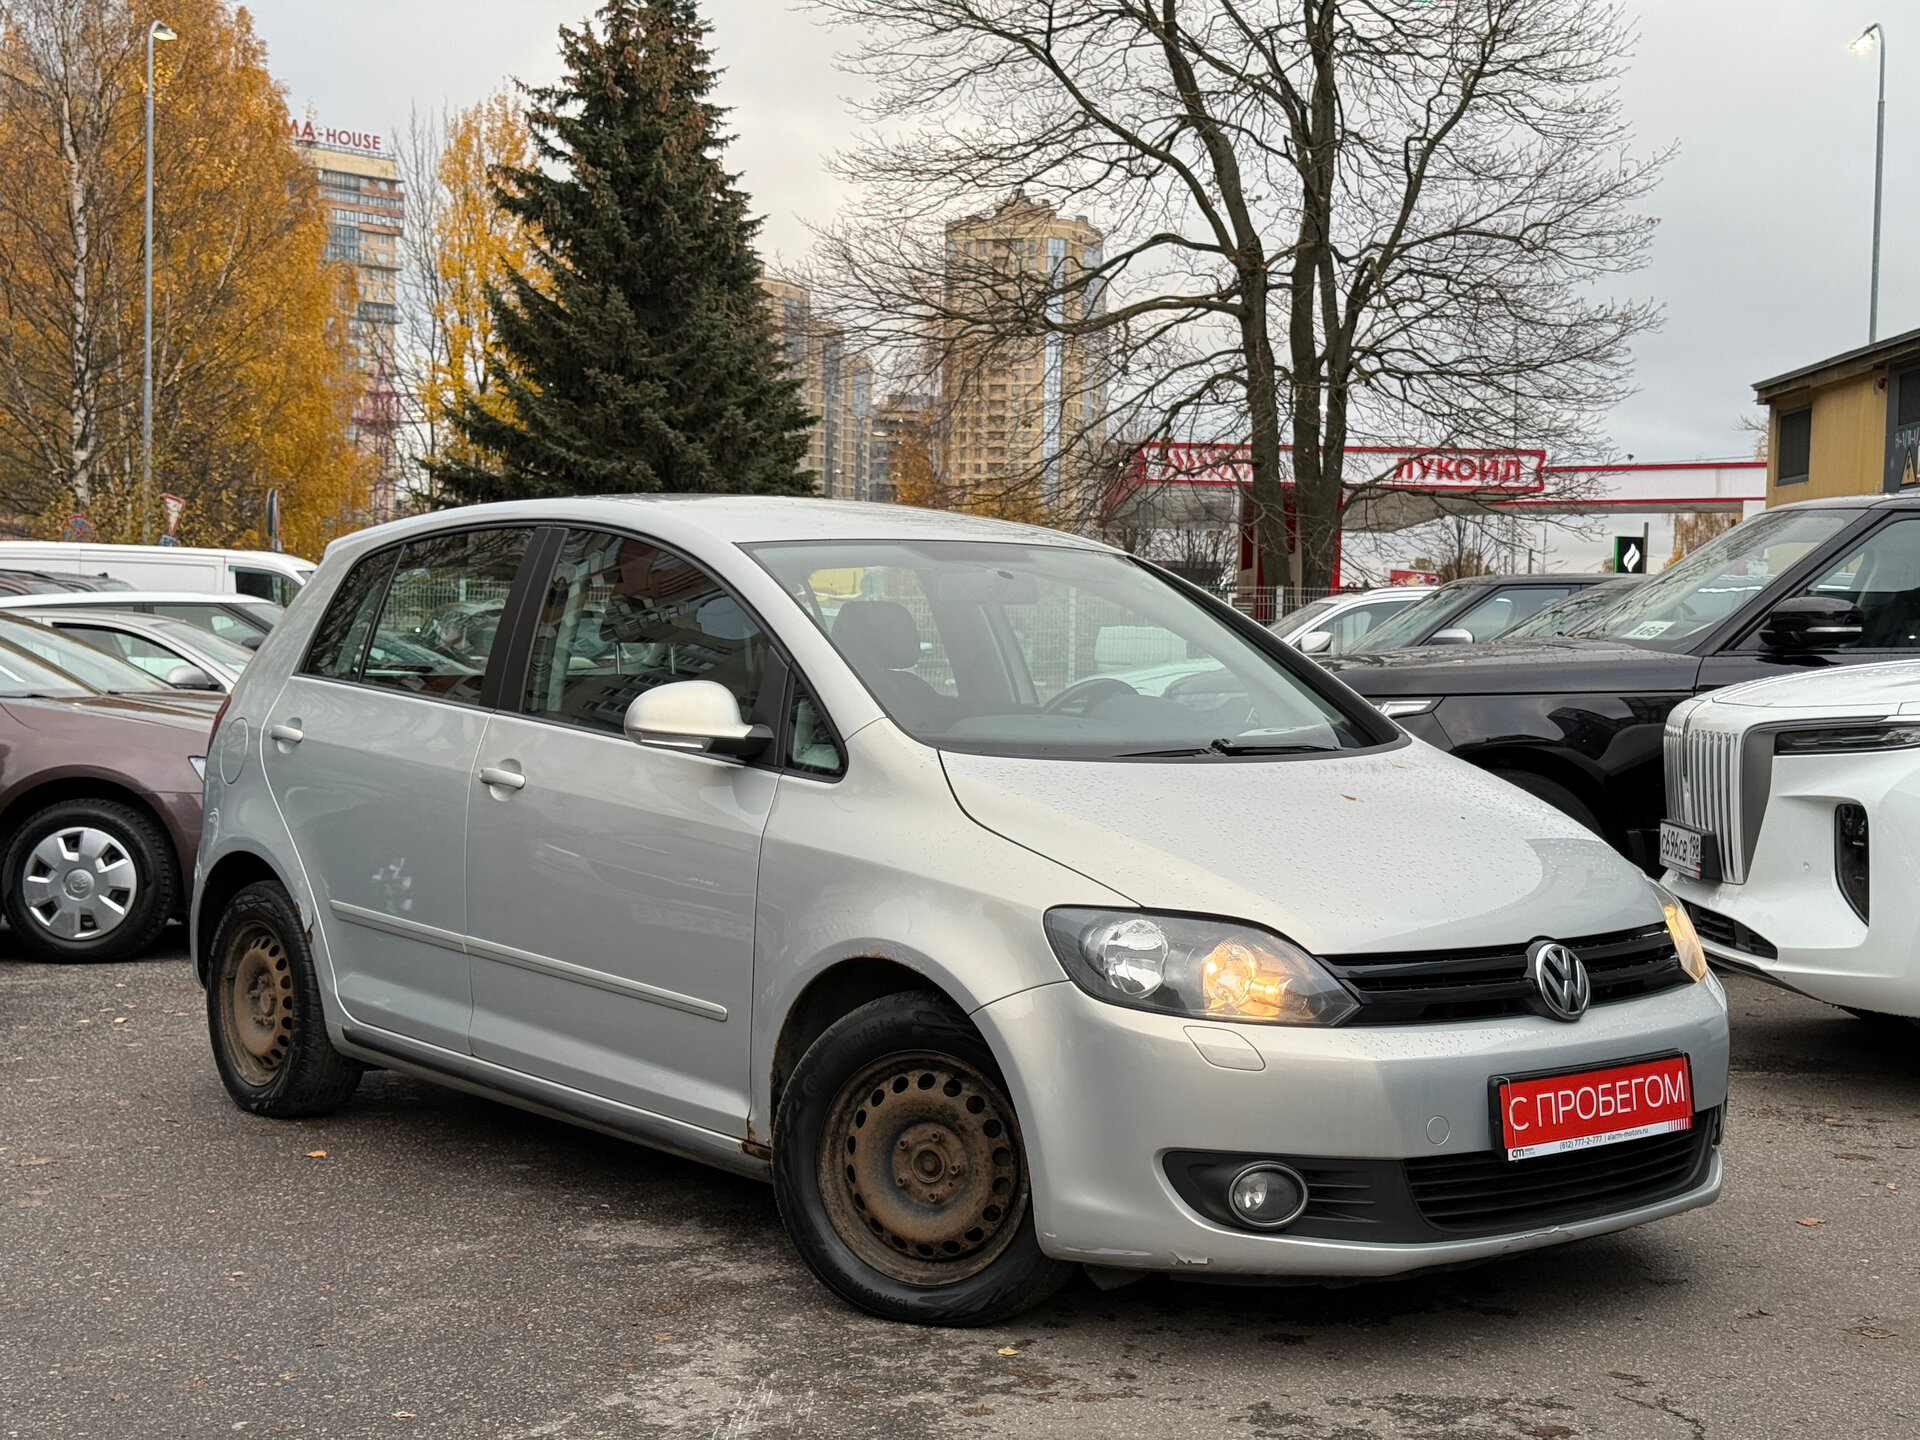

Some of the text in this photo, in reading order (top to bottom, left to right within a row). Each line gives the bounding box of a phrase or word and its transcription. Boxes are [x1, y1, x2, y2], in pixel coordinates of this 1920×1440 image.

[1509, 1070, 1686, 1131] С ПРОБЕГОМ
[1560, 1128, 1649, 1151] (812) 777-2-777 alarm-motors.ru
